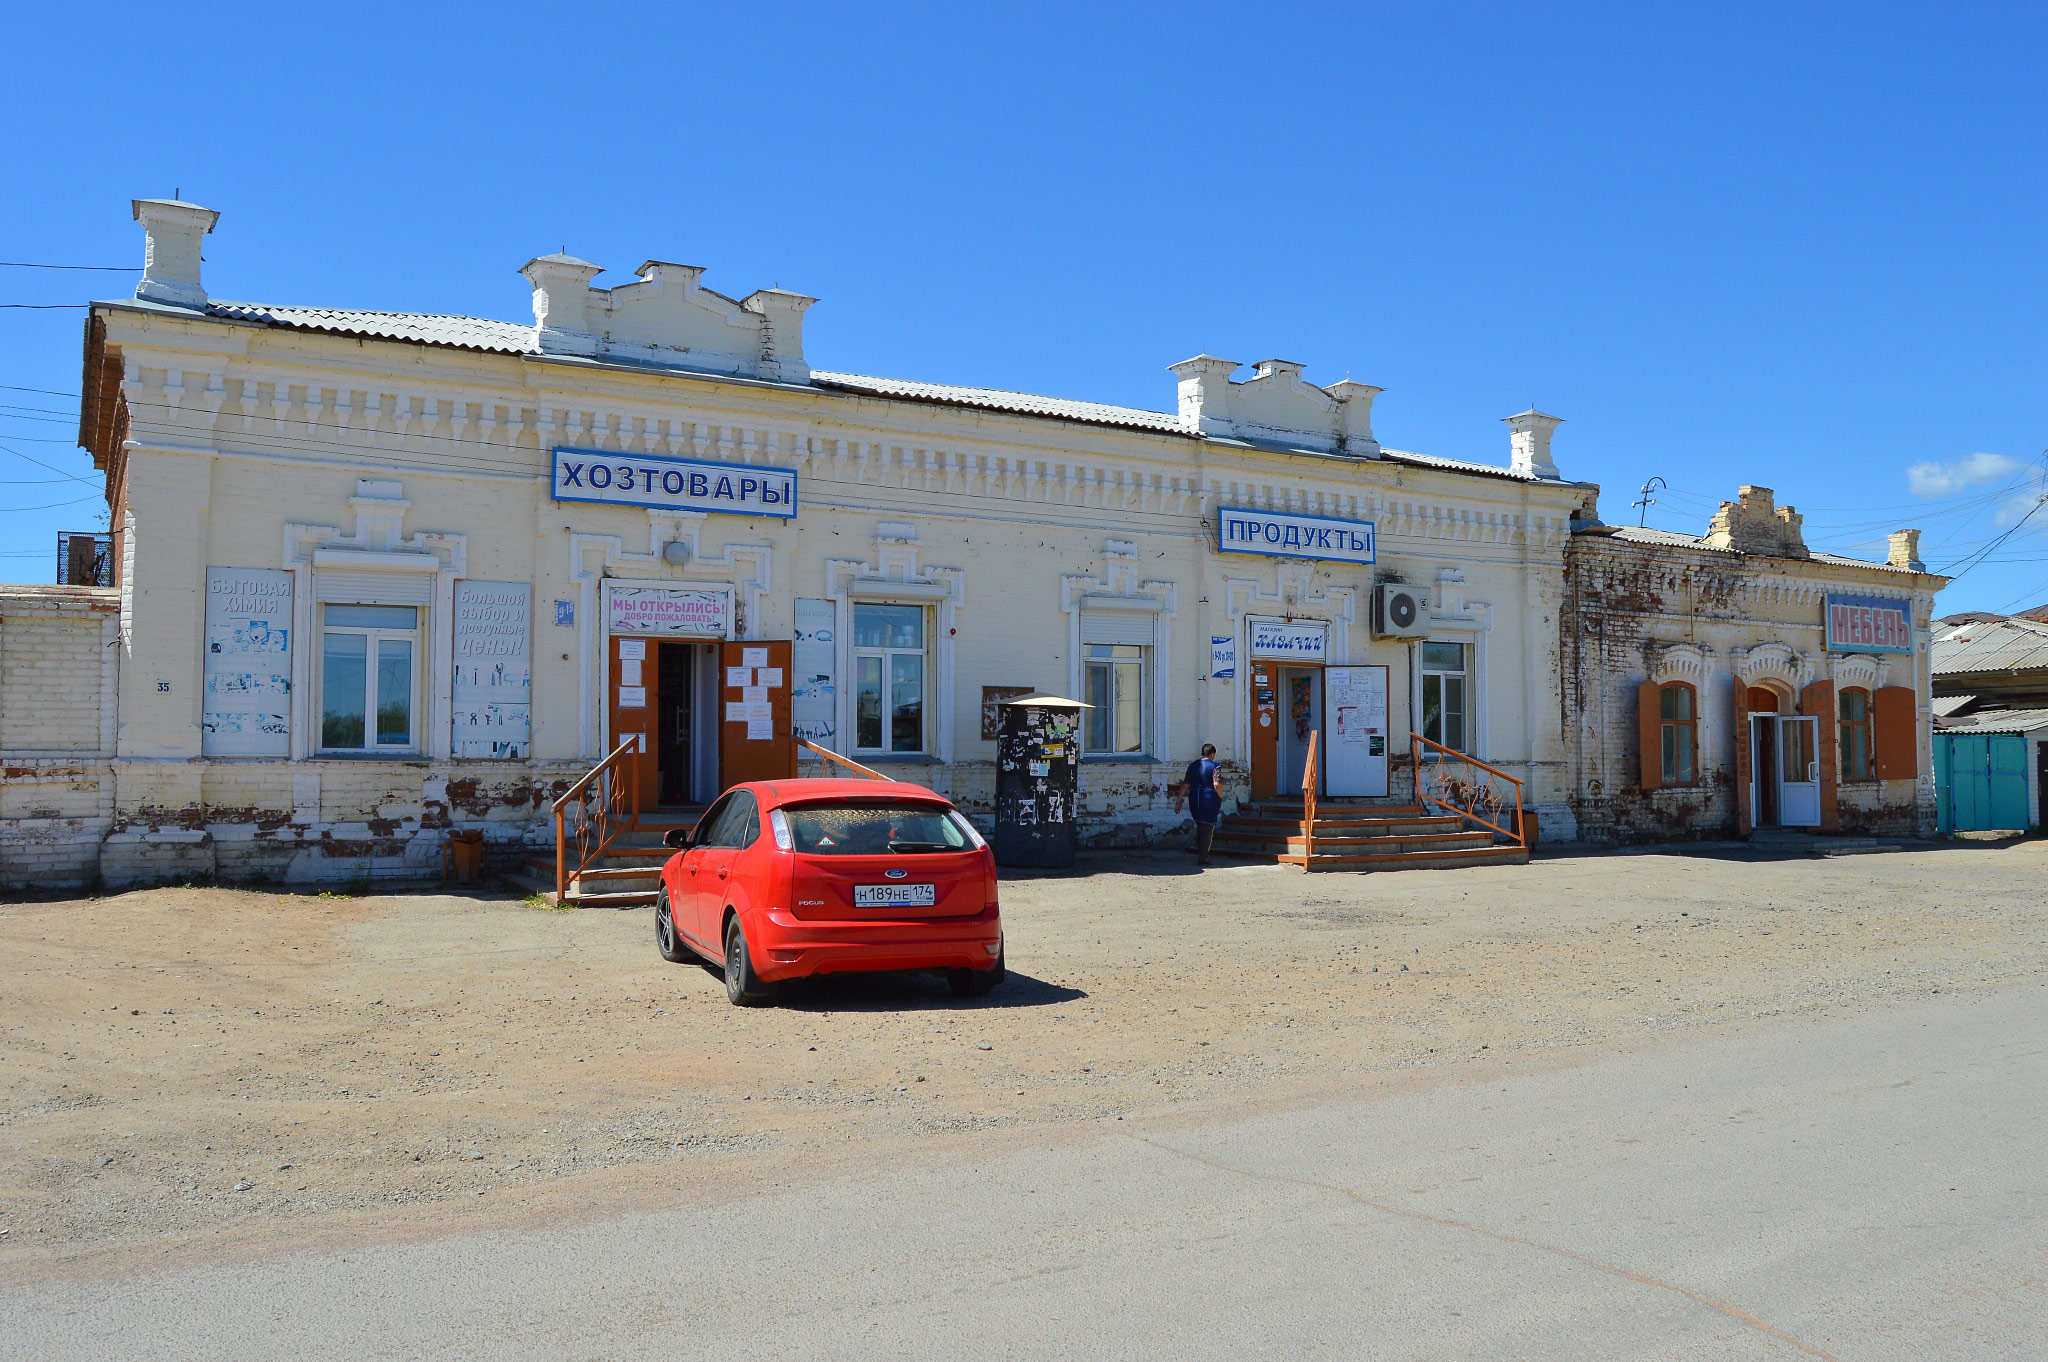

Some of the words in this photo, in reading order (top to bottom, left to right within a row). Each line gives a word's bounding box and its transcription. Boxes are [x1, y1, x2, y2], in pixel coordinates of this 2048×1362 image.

[561, 462, 790, 505] ХОЗТОВАРЫ
[1229, 519, 1371, 552] ПРОДУКТЫ
[211, 579, 291, 597] БЫТОВАЯ
[223, 597, 279, 613] ХИМИЯ
[613, 599, 636, 611] МЫ
[639, 600, 725, 614] ОТКРЫЛИСЬ!
[460, 606, 510, 624] выбор
[514, 610, 525, 621] и
[624, 612, 653, 621] ДОБРО
[654, 613, 715, 623] ПОЖАЛОВАТЬ!
[459, 624, 525, 637] доступные
[1831, 604, 1910, 648] МЕБЕЛЬ
[157, 682, 170, 692] 35
[912, 885, 933, 896] 174
